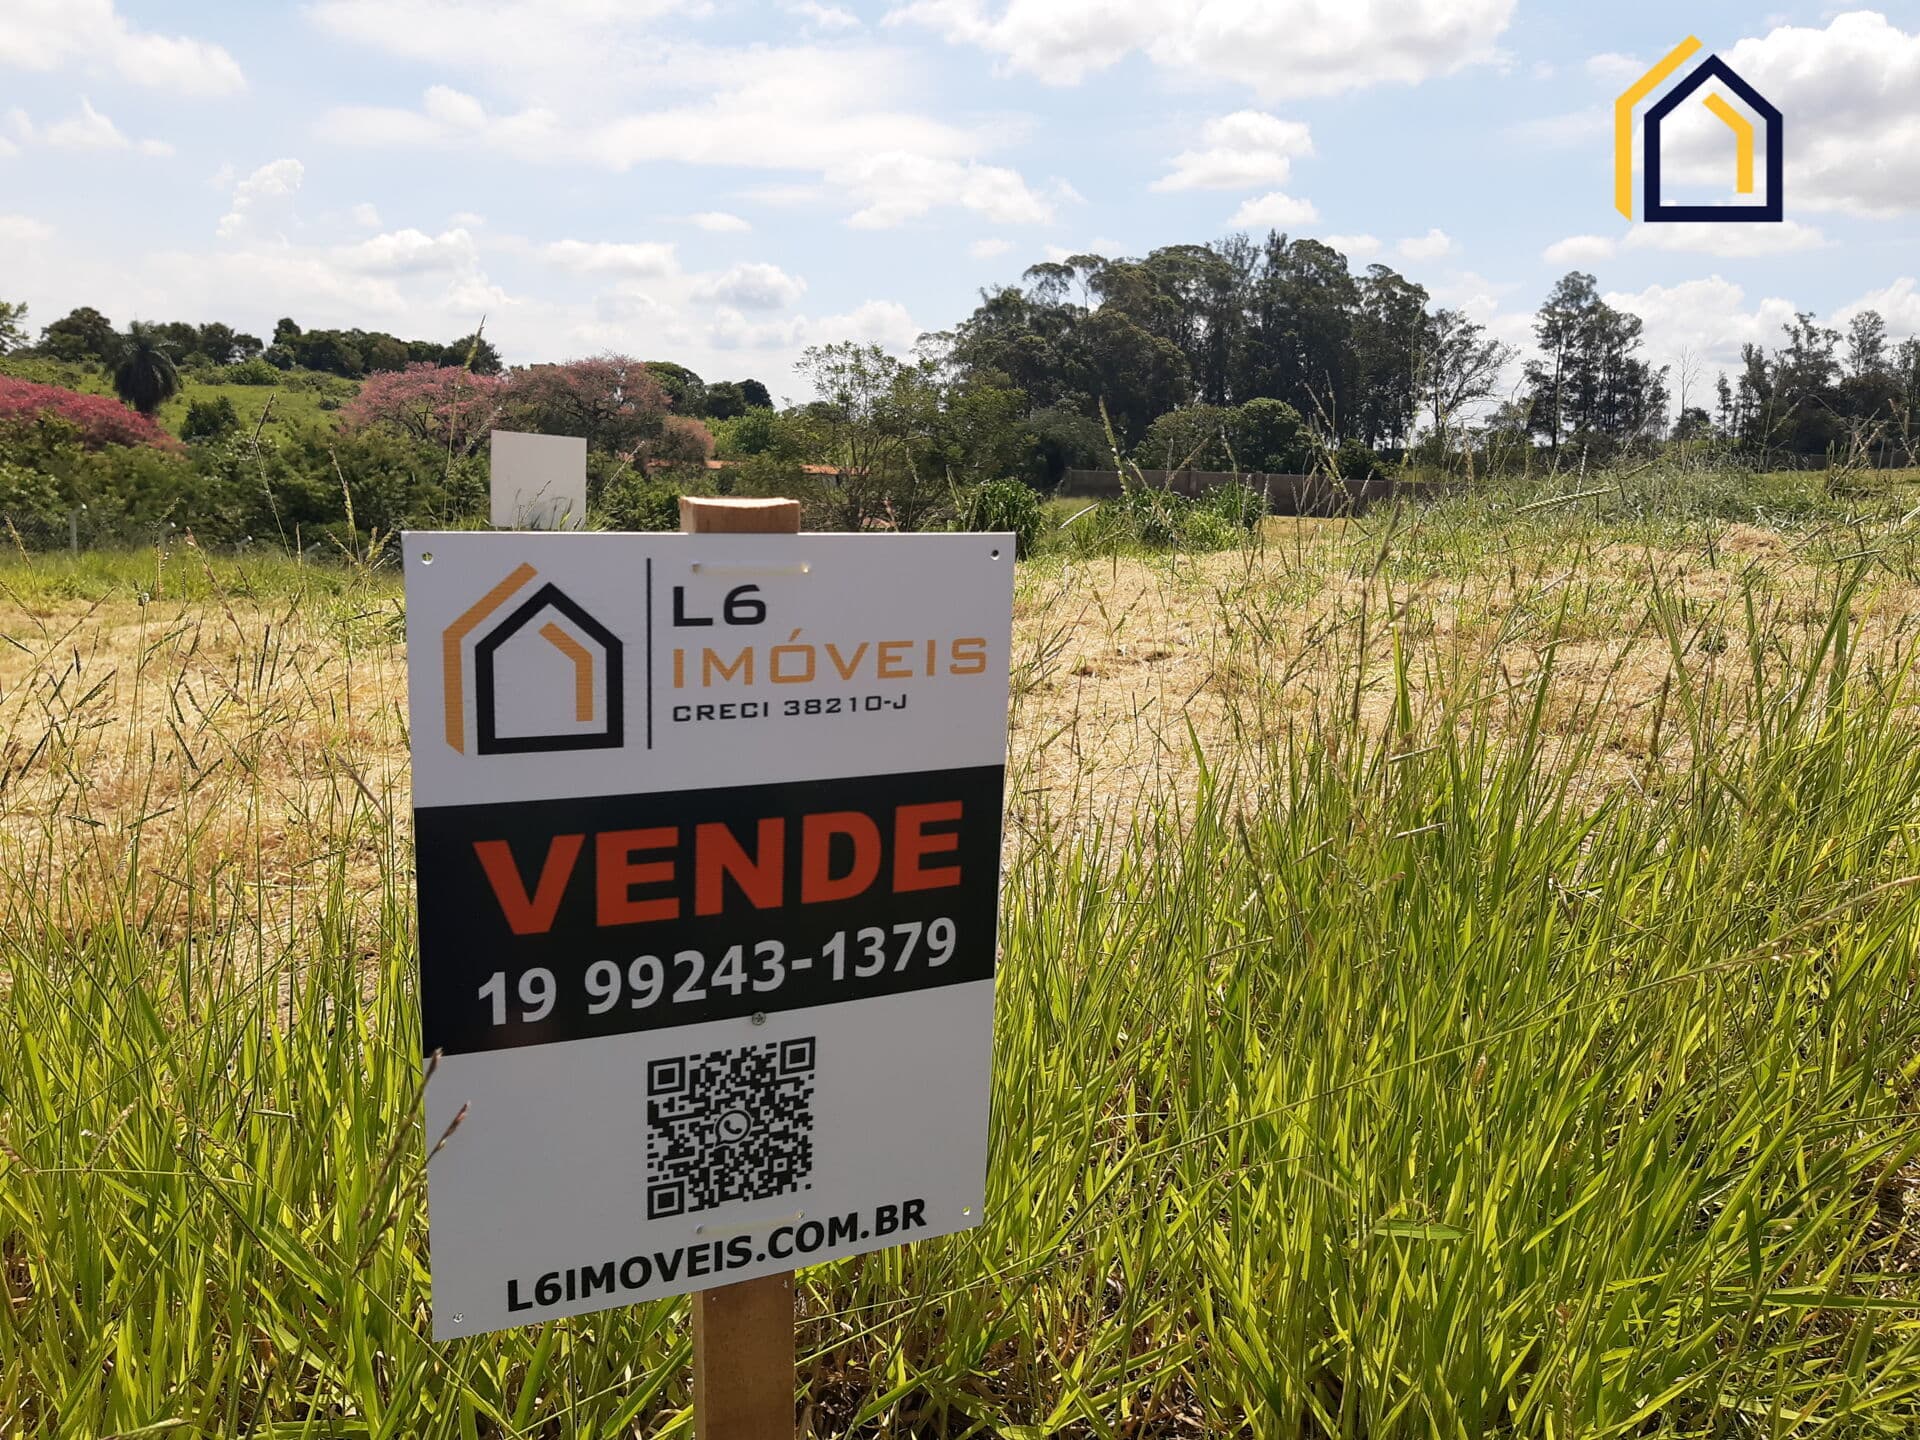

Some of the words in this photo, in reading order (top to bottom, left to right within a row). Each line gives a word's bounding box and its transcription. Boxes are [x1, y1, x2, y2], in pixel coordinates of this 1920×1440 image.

[673, 584, 767, 627] L6
[673, 628, 987, 689] IMÓVEIS
[673, 702, 769, 723] CRECI
[784, 694, 908, 717] 38210-J
[472, 800, 963, 936] VENDE
[477, 967, 558, 1026] 19
[584, 916, 957, 1015] 99243-1379
[507, 1198, 927, 1312] L6IMOVEIS.COM.BR
